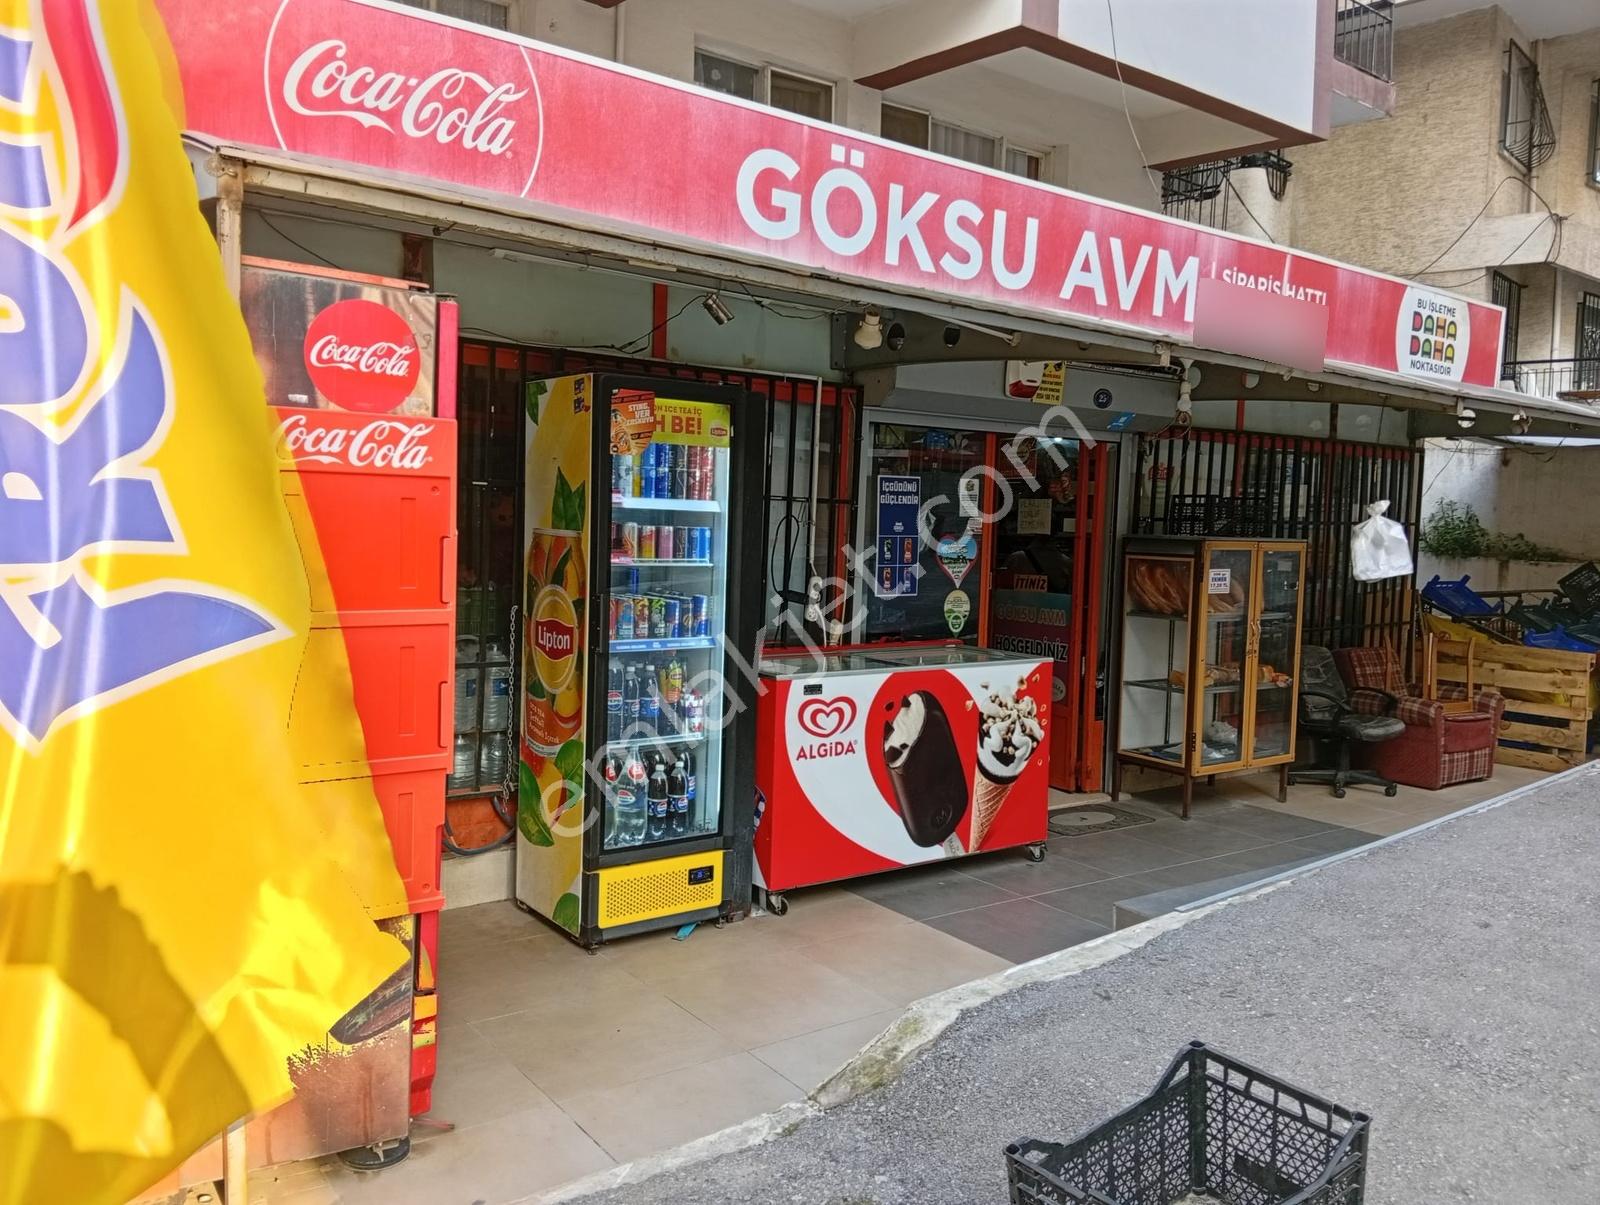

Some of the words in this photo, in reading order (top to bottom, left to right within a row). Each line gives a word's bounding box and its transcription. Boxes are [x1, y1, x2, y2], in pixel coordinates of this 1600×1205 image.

[283, 39, 530, 158] Coca-Cola
[736, 144, 1040, 291] GÖKSU
[1059, 231, 1200, 322] AVM
[1417, 299, 1427, 309] BU
[1412, 311, 1457, 341] DAHA
[310, 335, 415, 376] Coca-Cola
[1410, 335, 1455, 364] DAHA
[671, 415, 702, 435] BE!
[276, 414, 435, 470] Coca-Cola
[538, 625, 570, 651] Lipton
